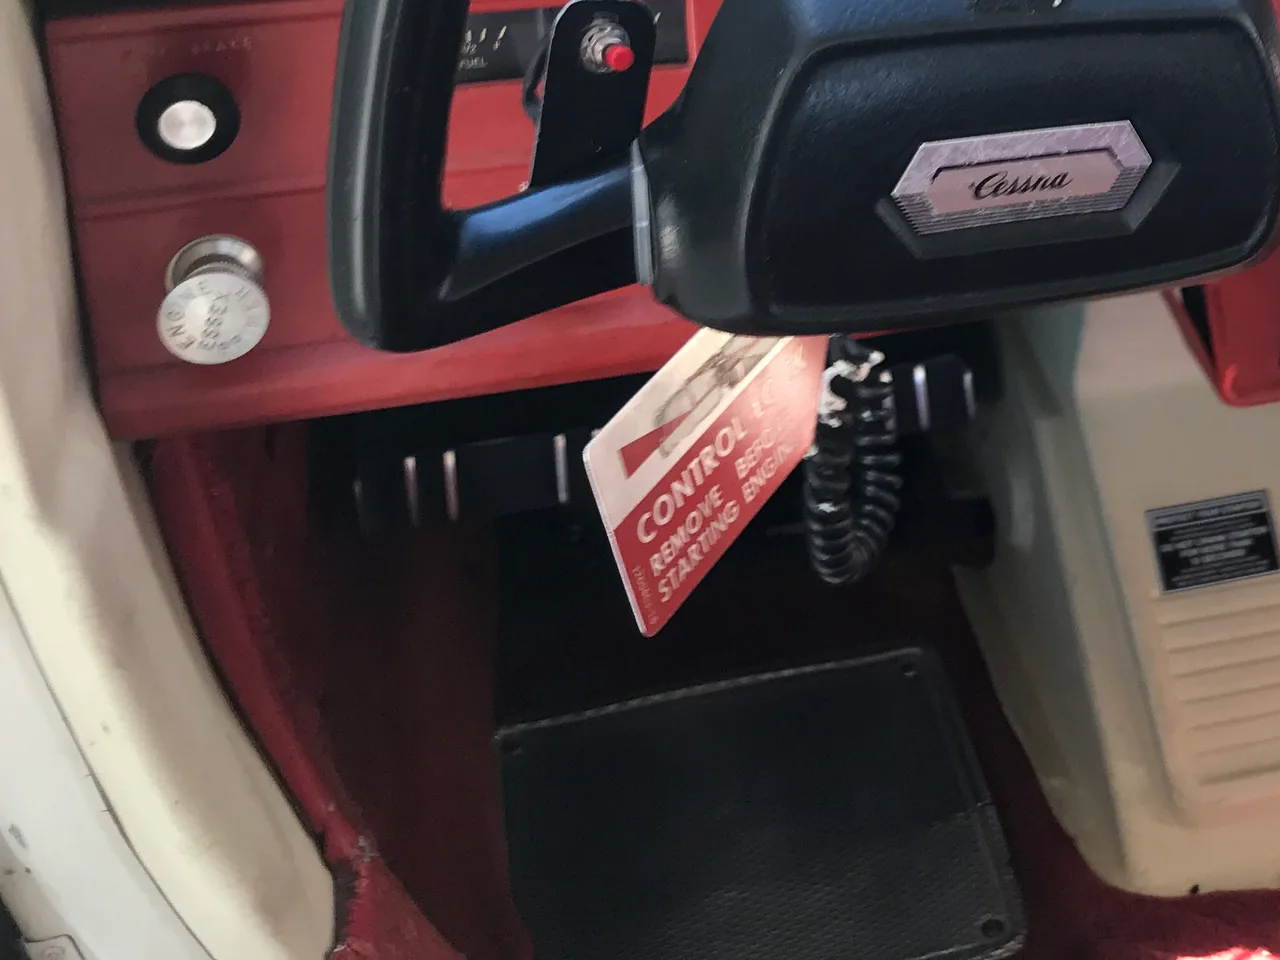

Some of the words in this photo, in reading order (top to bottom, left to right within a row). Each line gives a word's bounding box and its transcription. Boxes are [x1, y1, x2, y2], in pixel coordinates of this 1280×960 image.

[973, 170, 1074, 201] Cessna
[635, 416, 748, 545] CONTROL
[649, 483, 724, 578] REMOVE
[658, 499, 742, 604] STARTING
